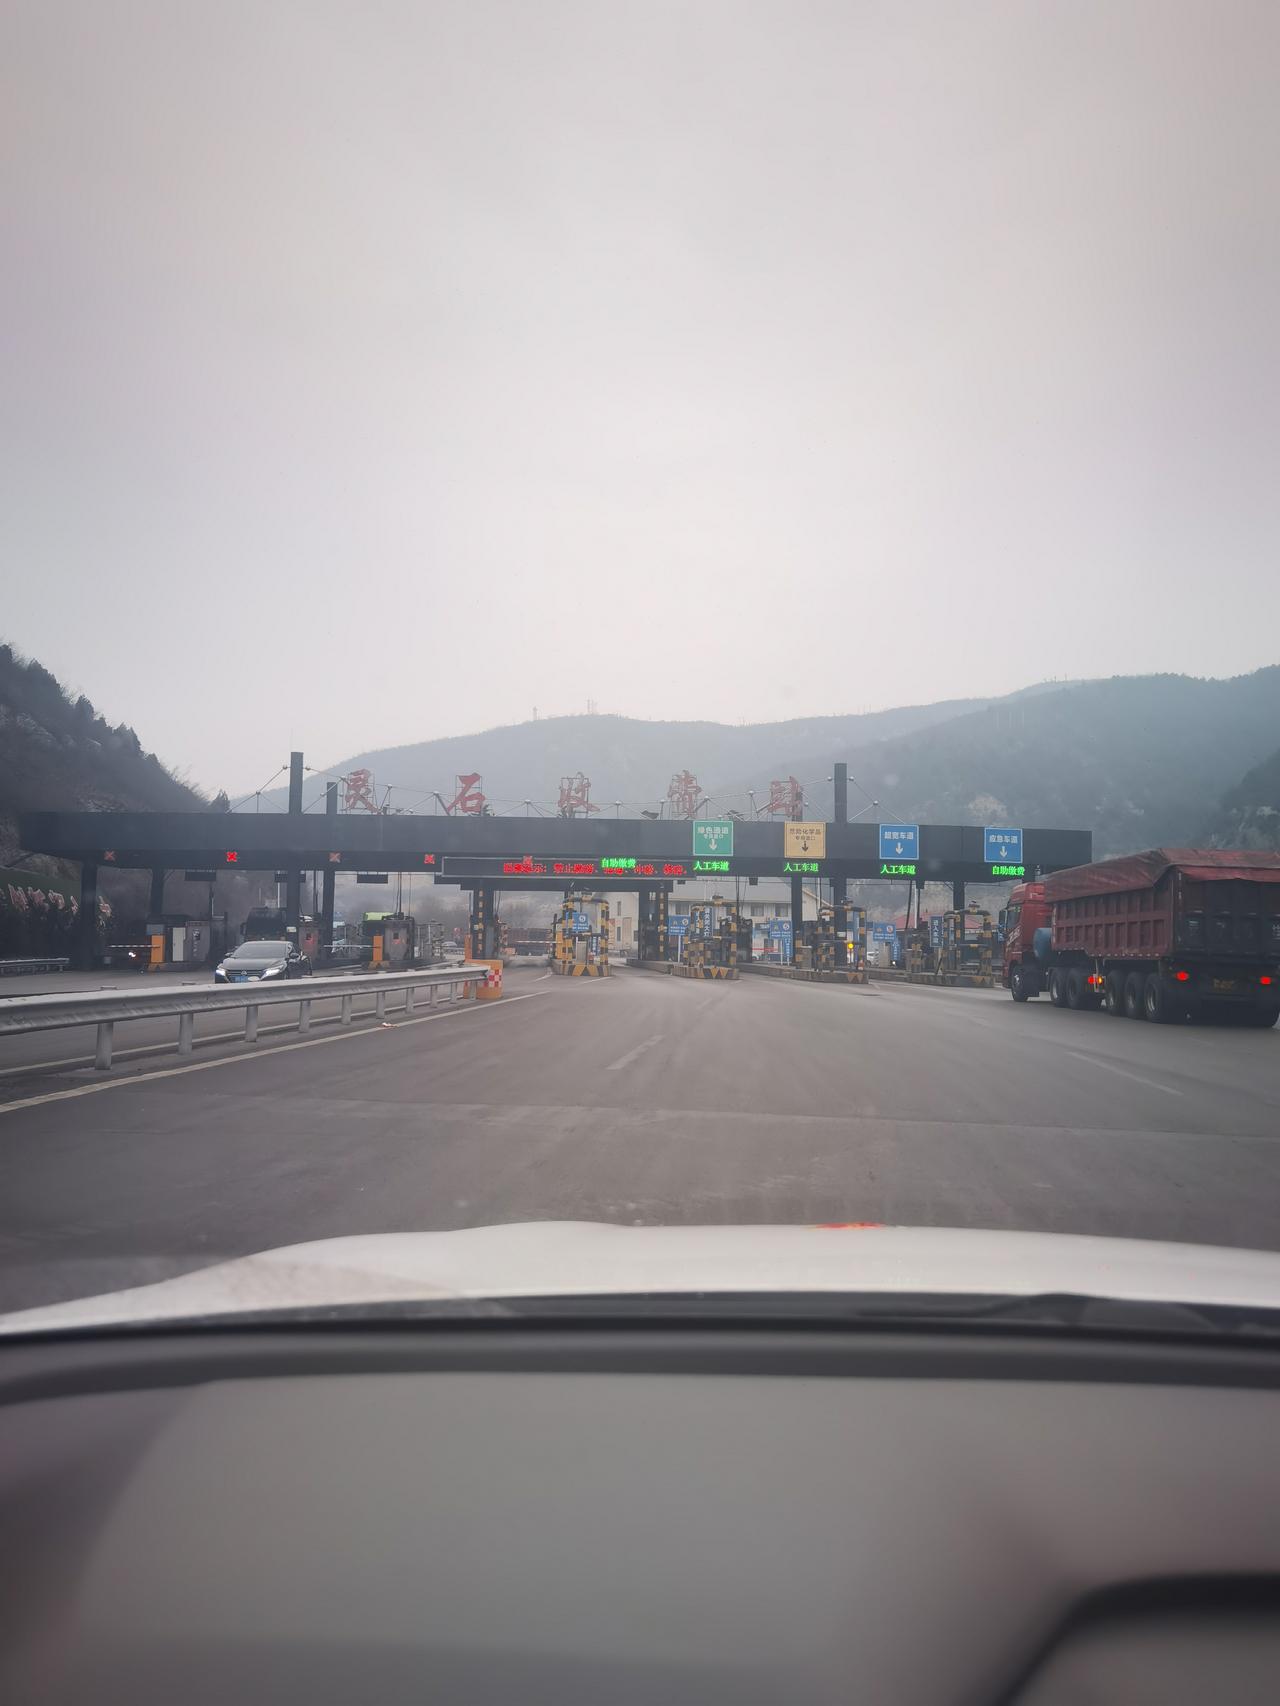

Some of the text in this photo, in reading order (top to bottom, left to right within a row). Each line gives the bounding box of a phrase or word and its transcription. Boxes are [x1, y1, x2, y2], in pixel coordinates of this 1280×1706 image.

[601, 858, 637, 868] 自助缴费
[693, 861, 729, 871] 人工车道
[783, 862, 819, 872] 人工车道
[880, 864, 916, 875] 人工车道
[992, 865, 1025, 876] 自助缴费
